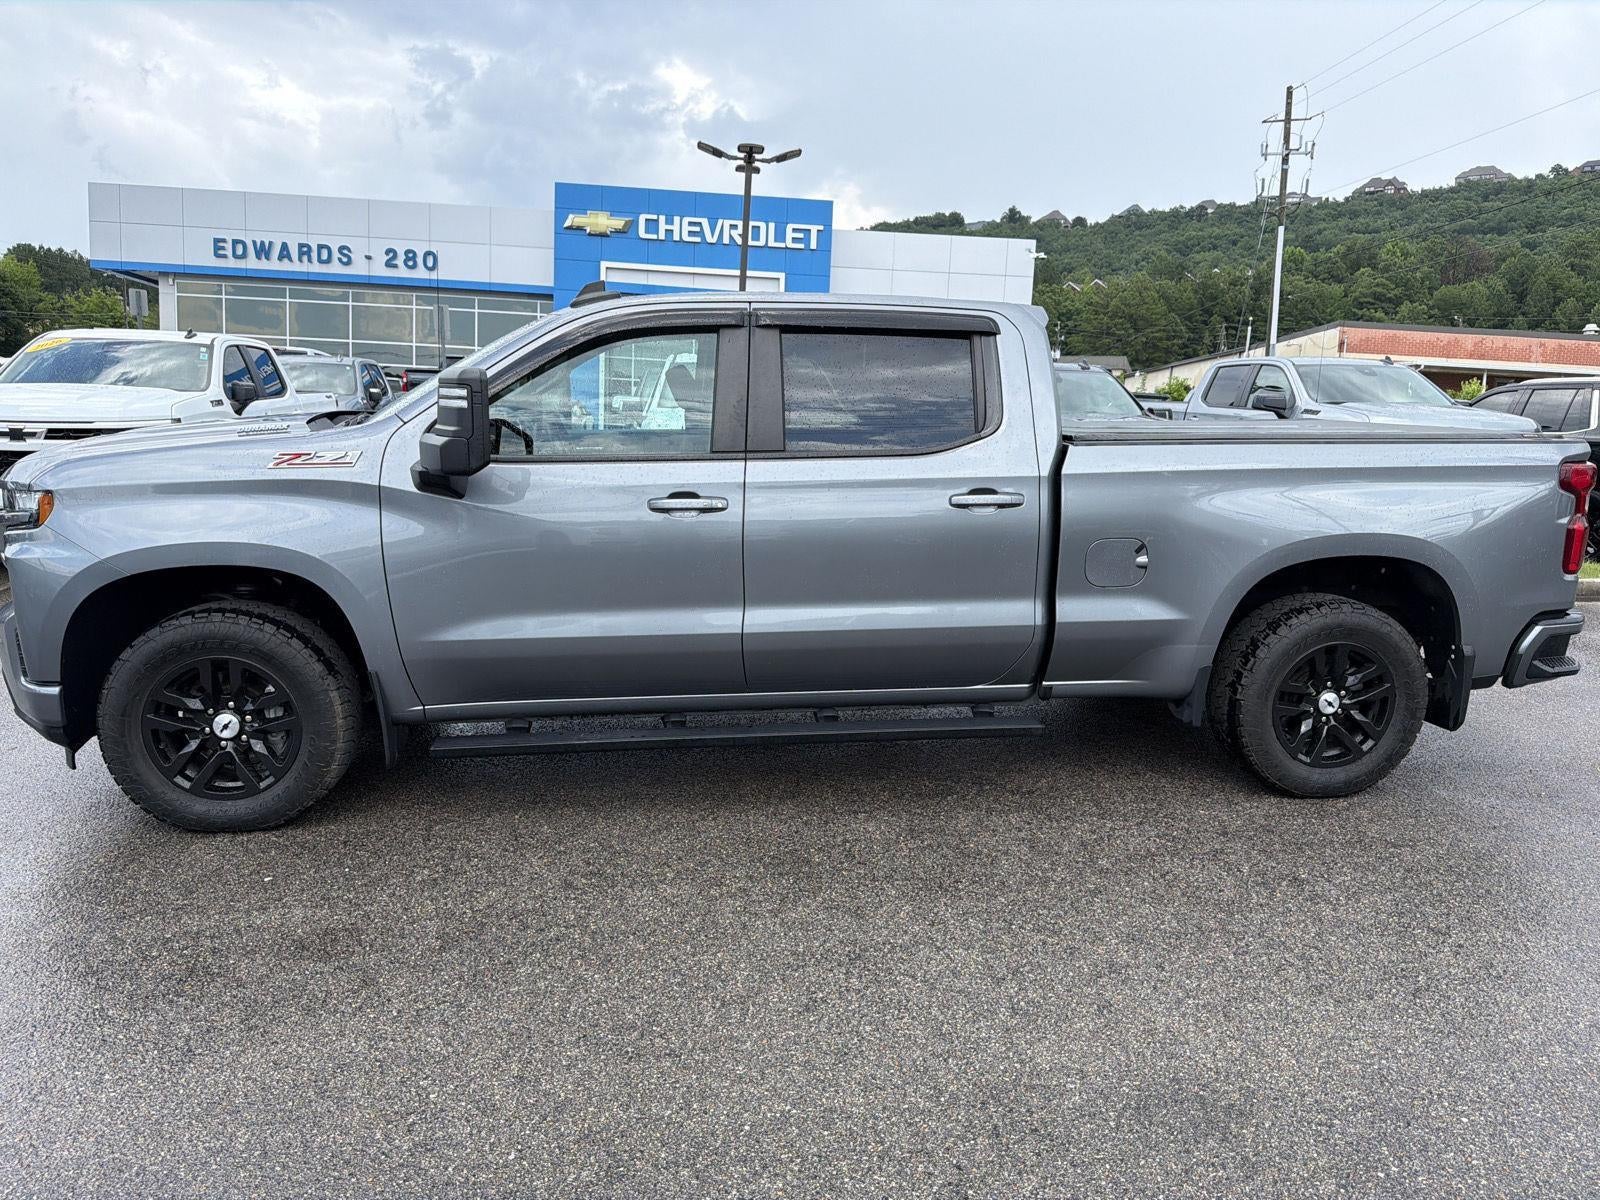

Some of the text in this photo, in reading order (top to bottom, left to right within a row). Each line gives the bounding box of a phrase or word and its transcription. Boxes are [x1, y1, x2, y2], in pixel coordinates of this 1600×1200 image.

[638, 213, 824, 250] CHEVROLET
[212, 237, 352, 266] EDWARDS
[384, 247, 438, 271] 280
[268, 451, 362, 469] Z71
